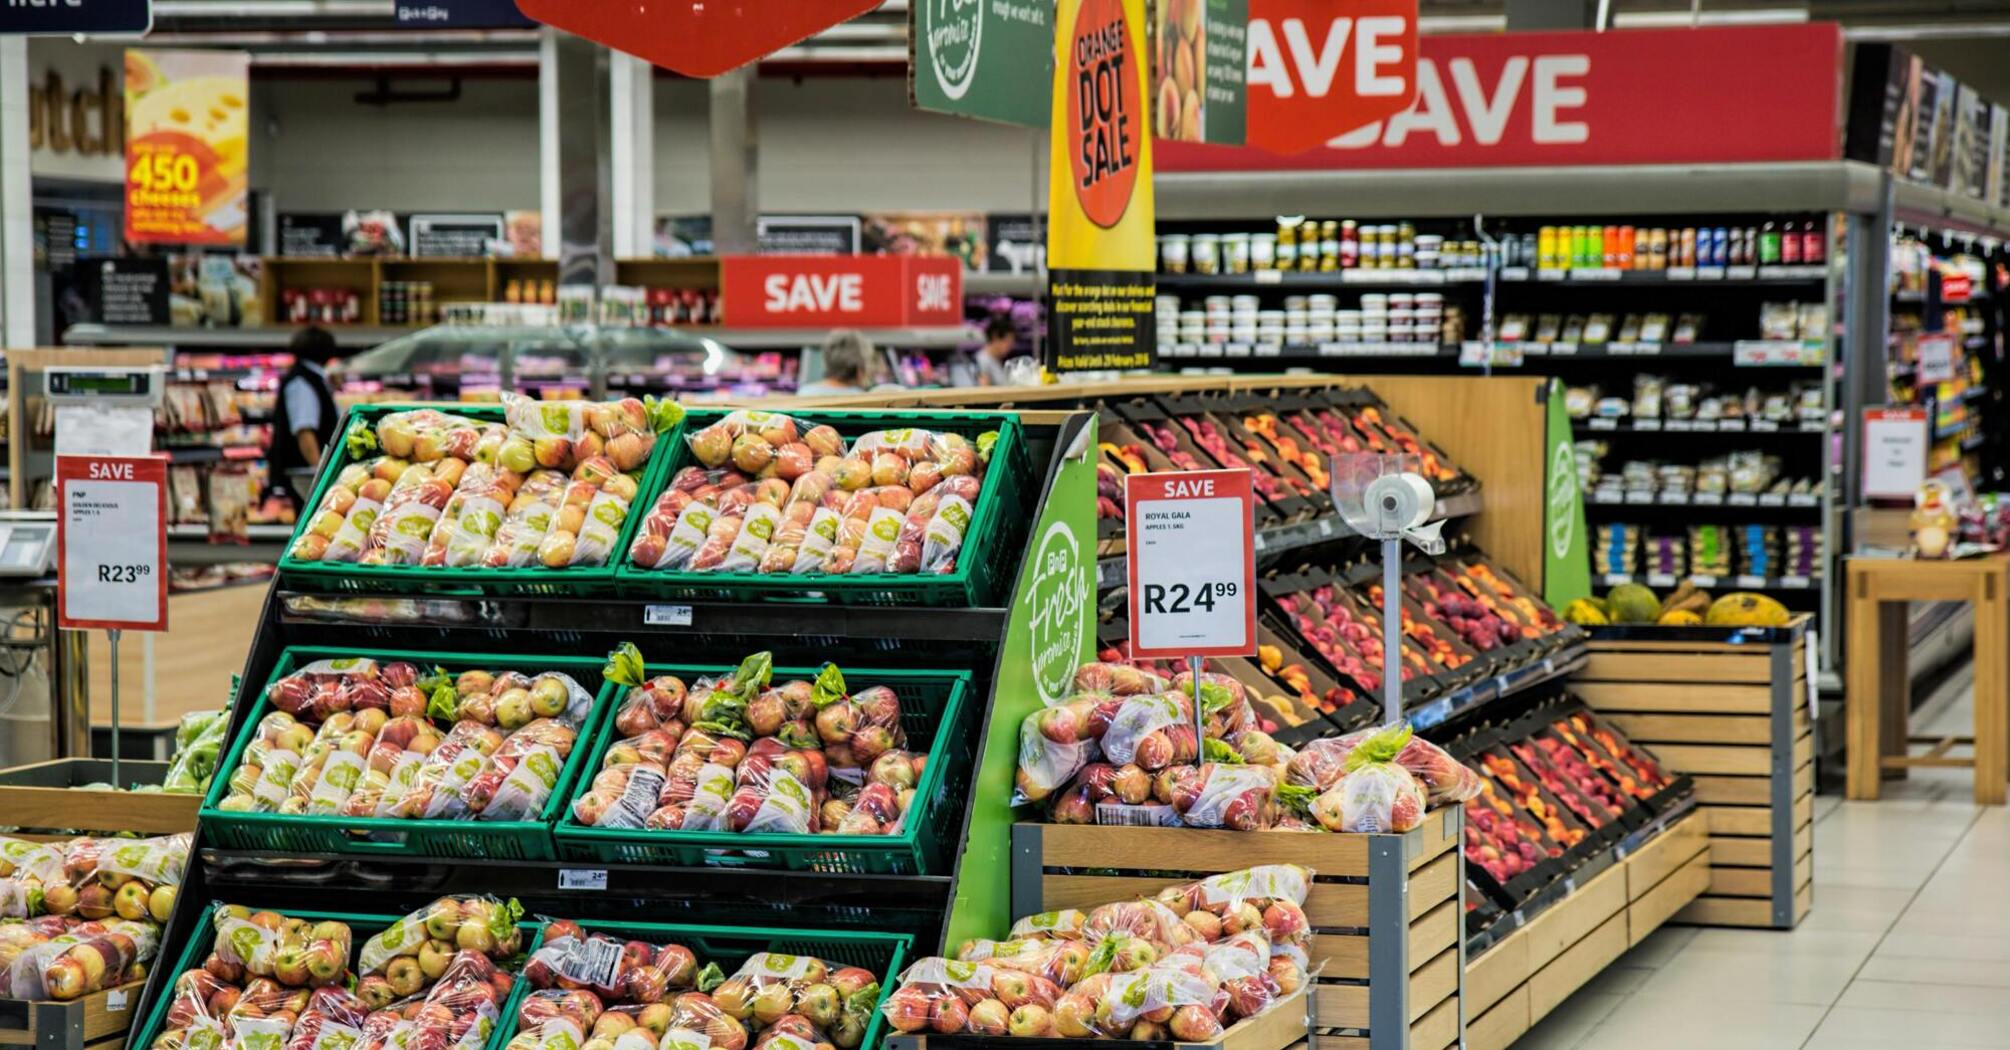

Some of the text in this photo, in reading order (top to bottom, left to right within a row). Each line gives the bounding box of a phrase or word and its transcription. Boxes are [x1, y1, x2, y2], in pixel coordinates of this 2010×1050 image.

[1077, 19, 1124, 68] ORANGE
[1246, 16, 1406, 98] AVE
[1078, 53, 1125, 133] DOT
[1326, 55, 1591, 149] AVE
[129, 152, 199, 192] 450
[1080, 115, 1132, 189] SALE
[764, 273, 864, 313] SAVE
[916, 273, 952, 313] SAVE
[89, 463, 134, 480] SAVE
[1164, 479, 1215, 498] SAVE
[1145, 511, 1191, 521] ROYAL GALA
[1025, 540, 1090, 643] Fresh
